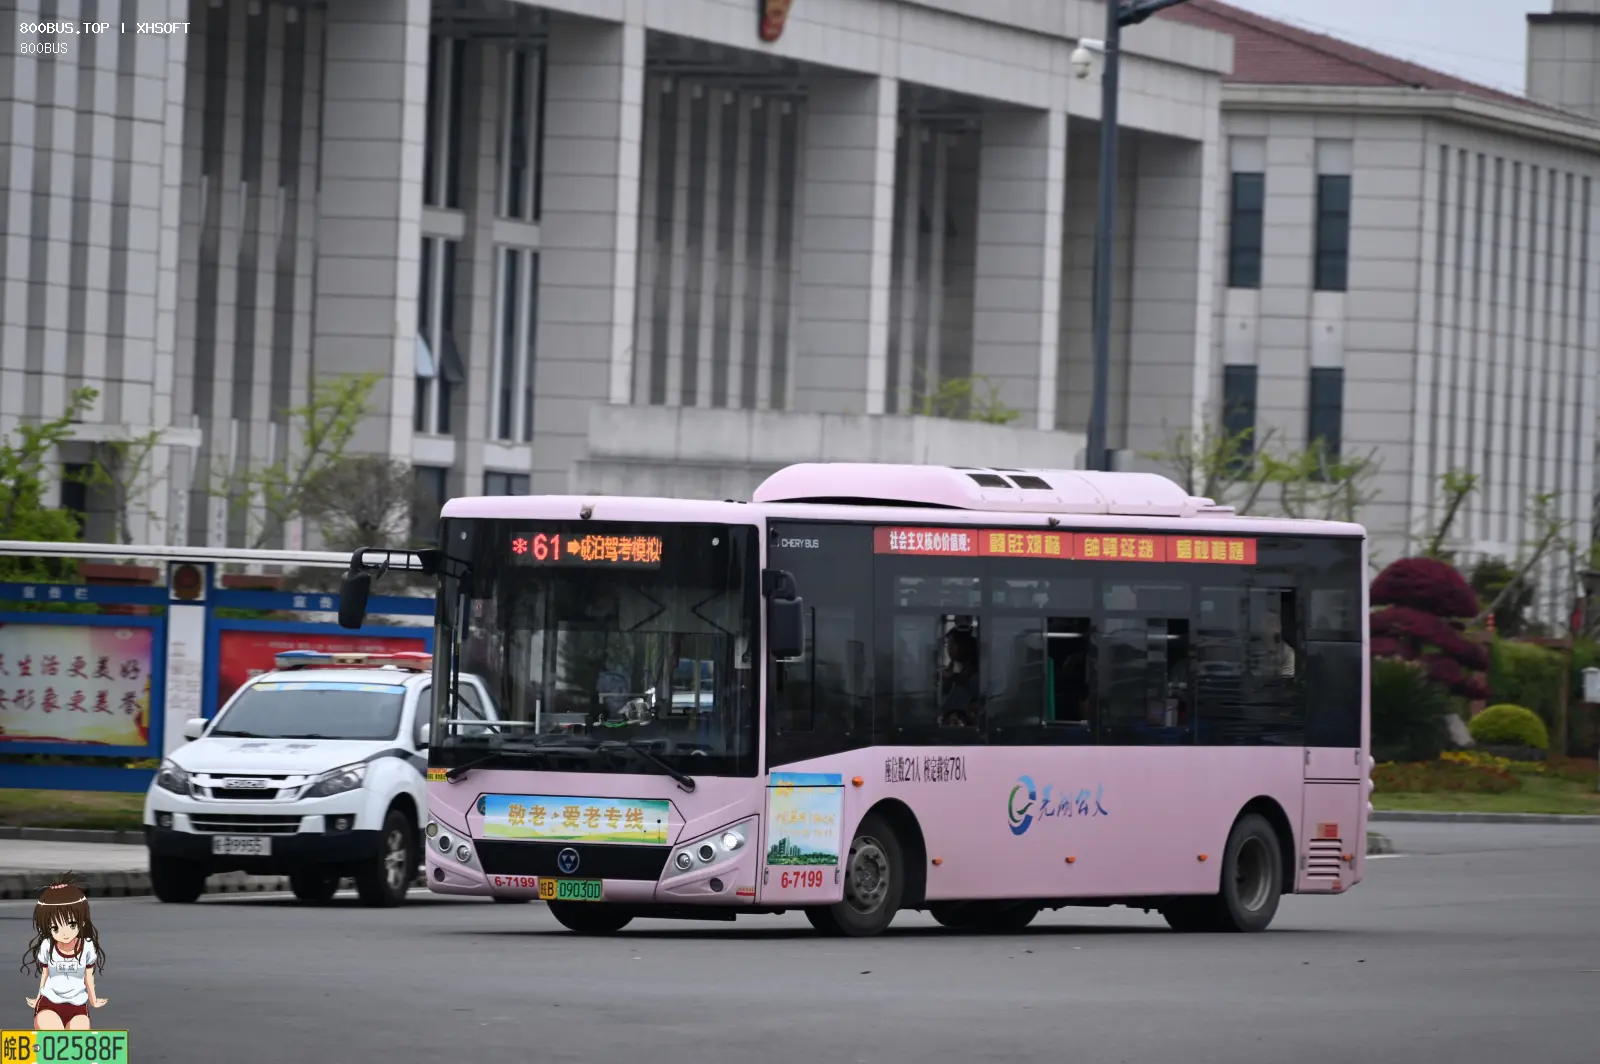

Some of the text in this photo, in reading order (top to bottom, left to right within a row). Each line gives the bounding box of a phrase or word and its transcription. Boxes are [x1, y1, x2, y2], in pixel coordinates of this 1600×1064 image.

[533, 533, 560, 560] 61
[781, 538, 819, 548] CHERY BUS
[494, 876, 536, 888] 6-7199
[781, 870, 823, 888] 6-7199
[559, 882, 600, 899] 09030D
